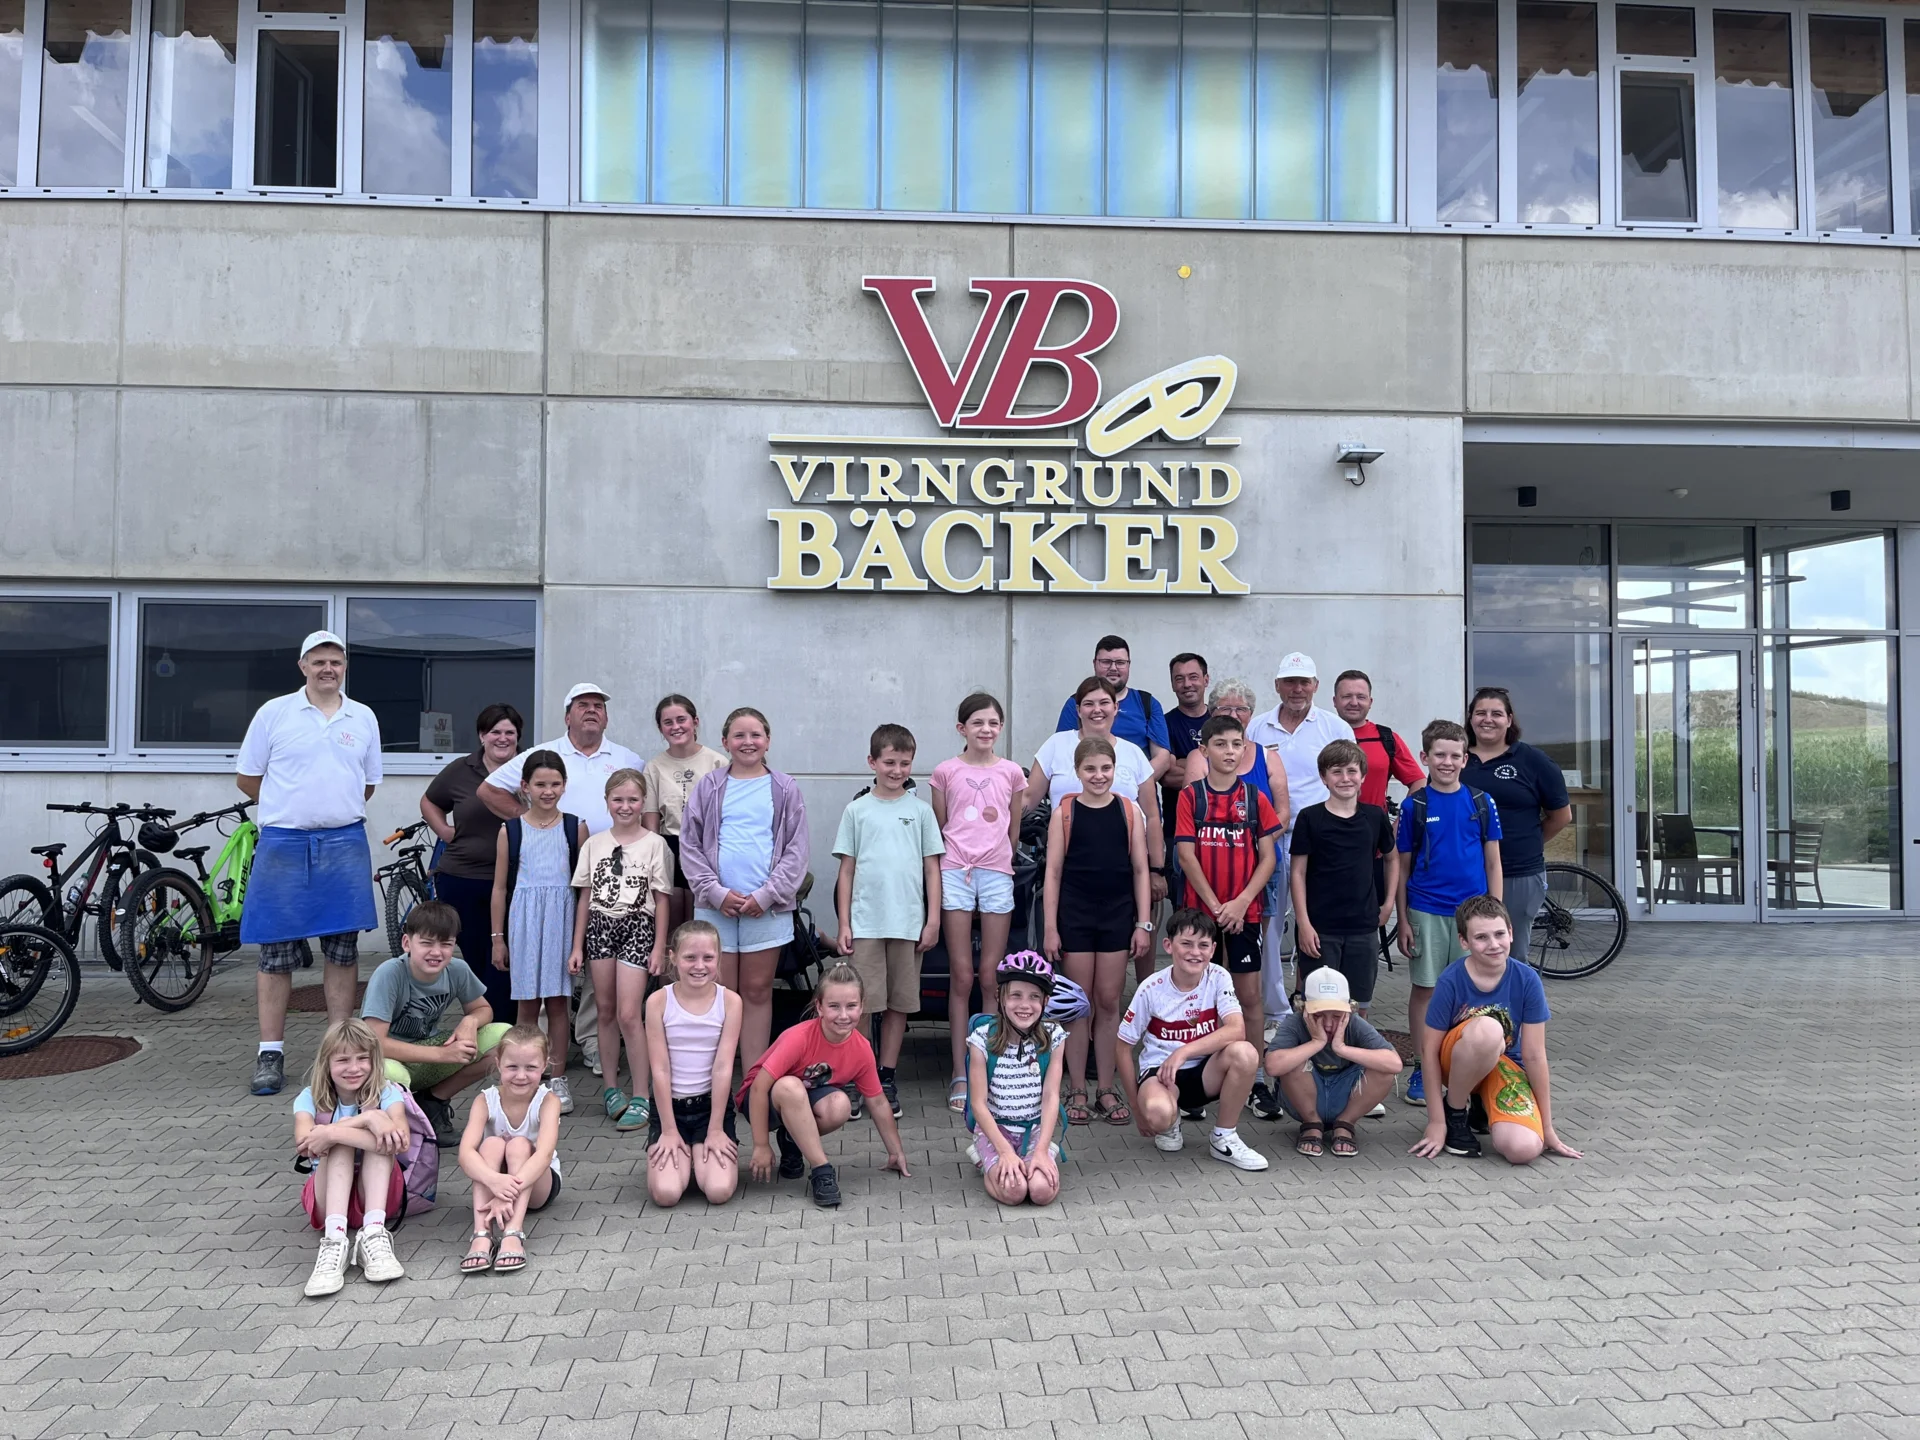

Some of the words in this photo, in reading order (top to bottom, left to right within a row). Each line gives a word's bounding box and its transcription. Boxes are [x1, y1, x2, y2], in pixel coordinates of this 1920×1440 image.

[862, 275, 1120, 428] VB
[769, 455, 1242, 507] VIRNGRUND
[767, 508, 1250, 594] BÄCKER
[238, 858, 249, 904] CUBE
